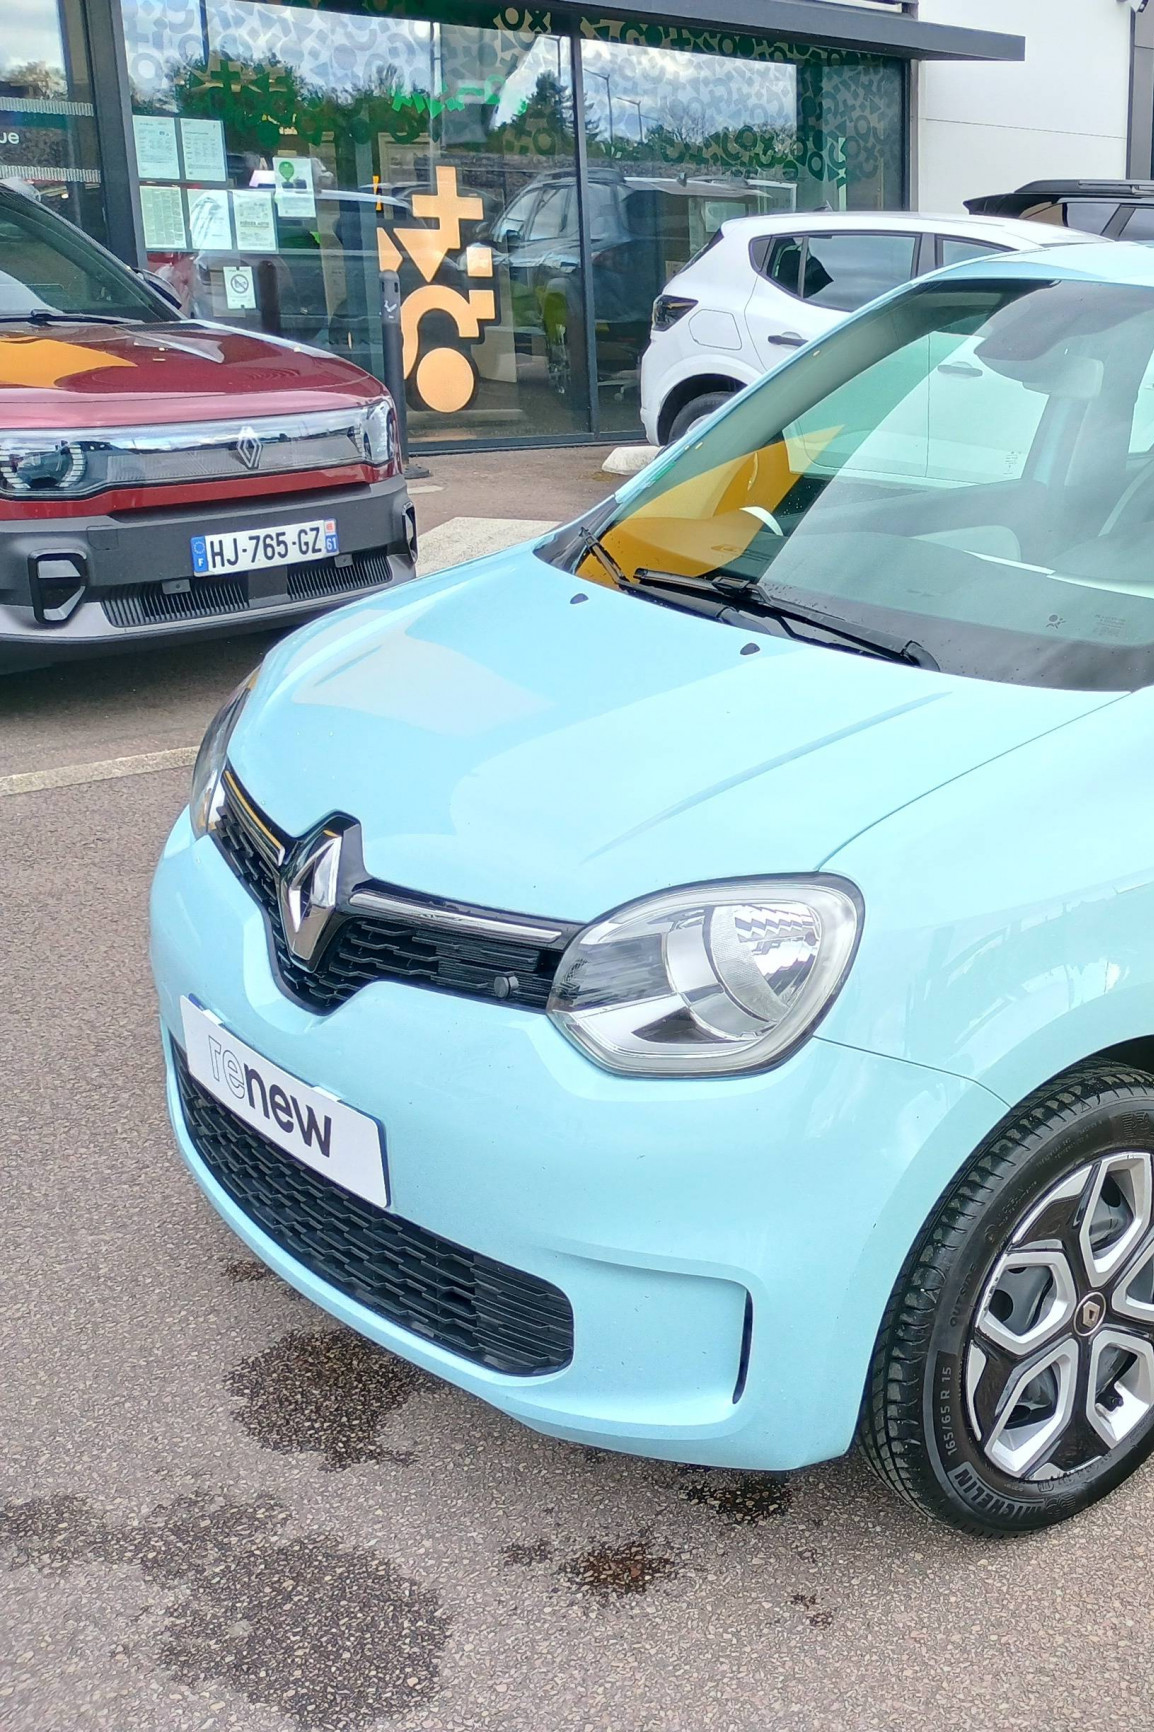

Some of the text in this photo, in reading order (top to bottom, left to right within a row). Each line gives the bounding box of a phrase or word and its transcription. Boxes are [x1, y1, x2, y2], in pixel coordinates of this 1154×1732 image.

[198, 558, 205, 567] F
[210, 526, 322, 569] HJ-765-GZ
[326, 537, 338, 551] 61
[208, 1034, 332, 1158] renew
[940, 1367, 958, 1456] 165/65 R 15
